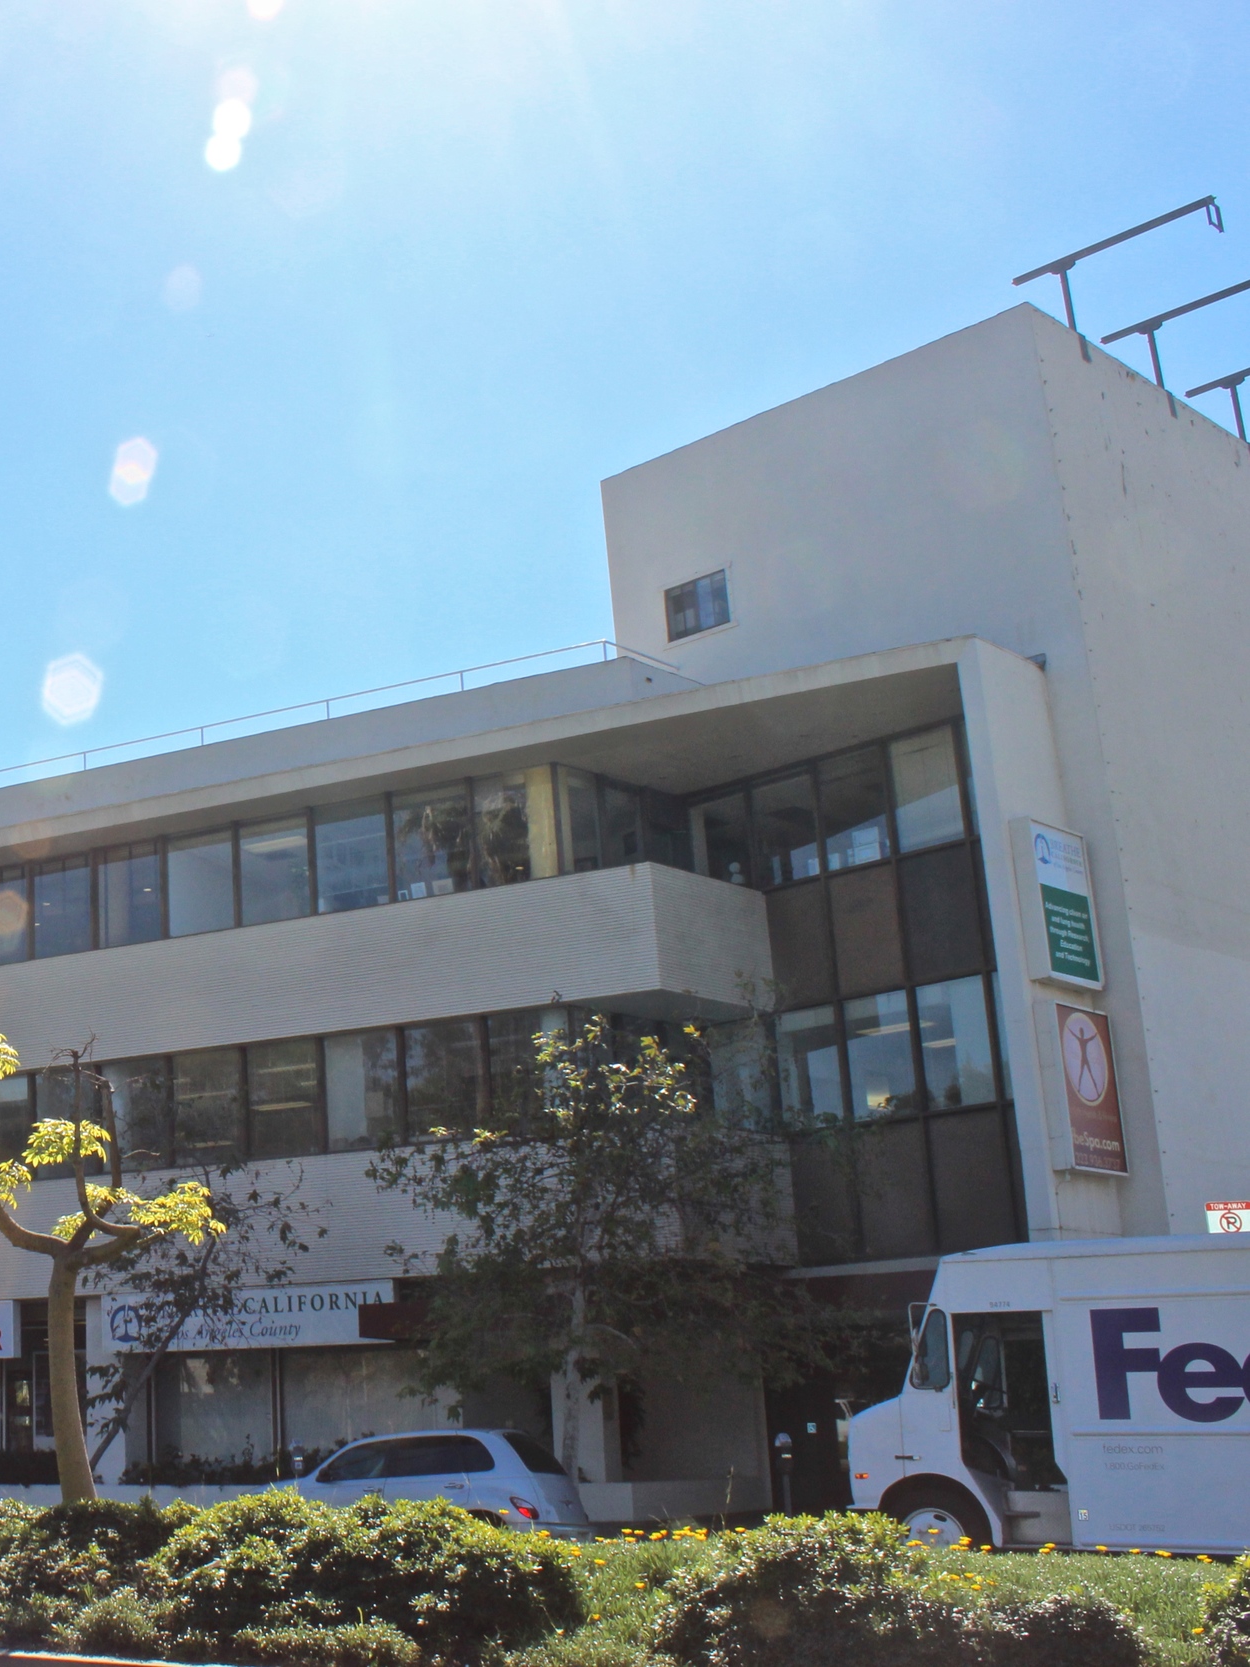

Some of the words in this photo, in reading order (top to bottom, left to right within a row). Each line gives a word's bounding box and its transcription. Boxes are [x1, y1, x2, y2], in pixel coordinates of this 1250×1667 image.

[243, 1291, 383, 1315] CALIFORNIA
[249, 1318, 301, 1341] County
[1090, 1307, 1250, 1423] Fe
[1102, 1443, 1163, 1454] fedex.com
